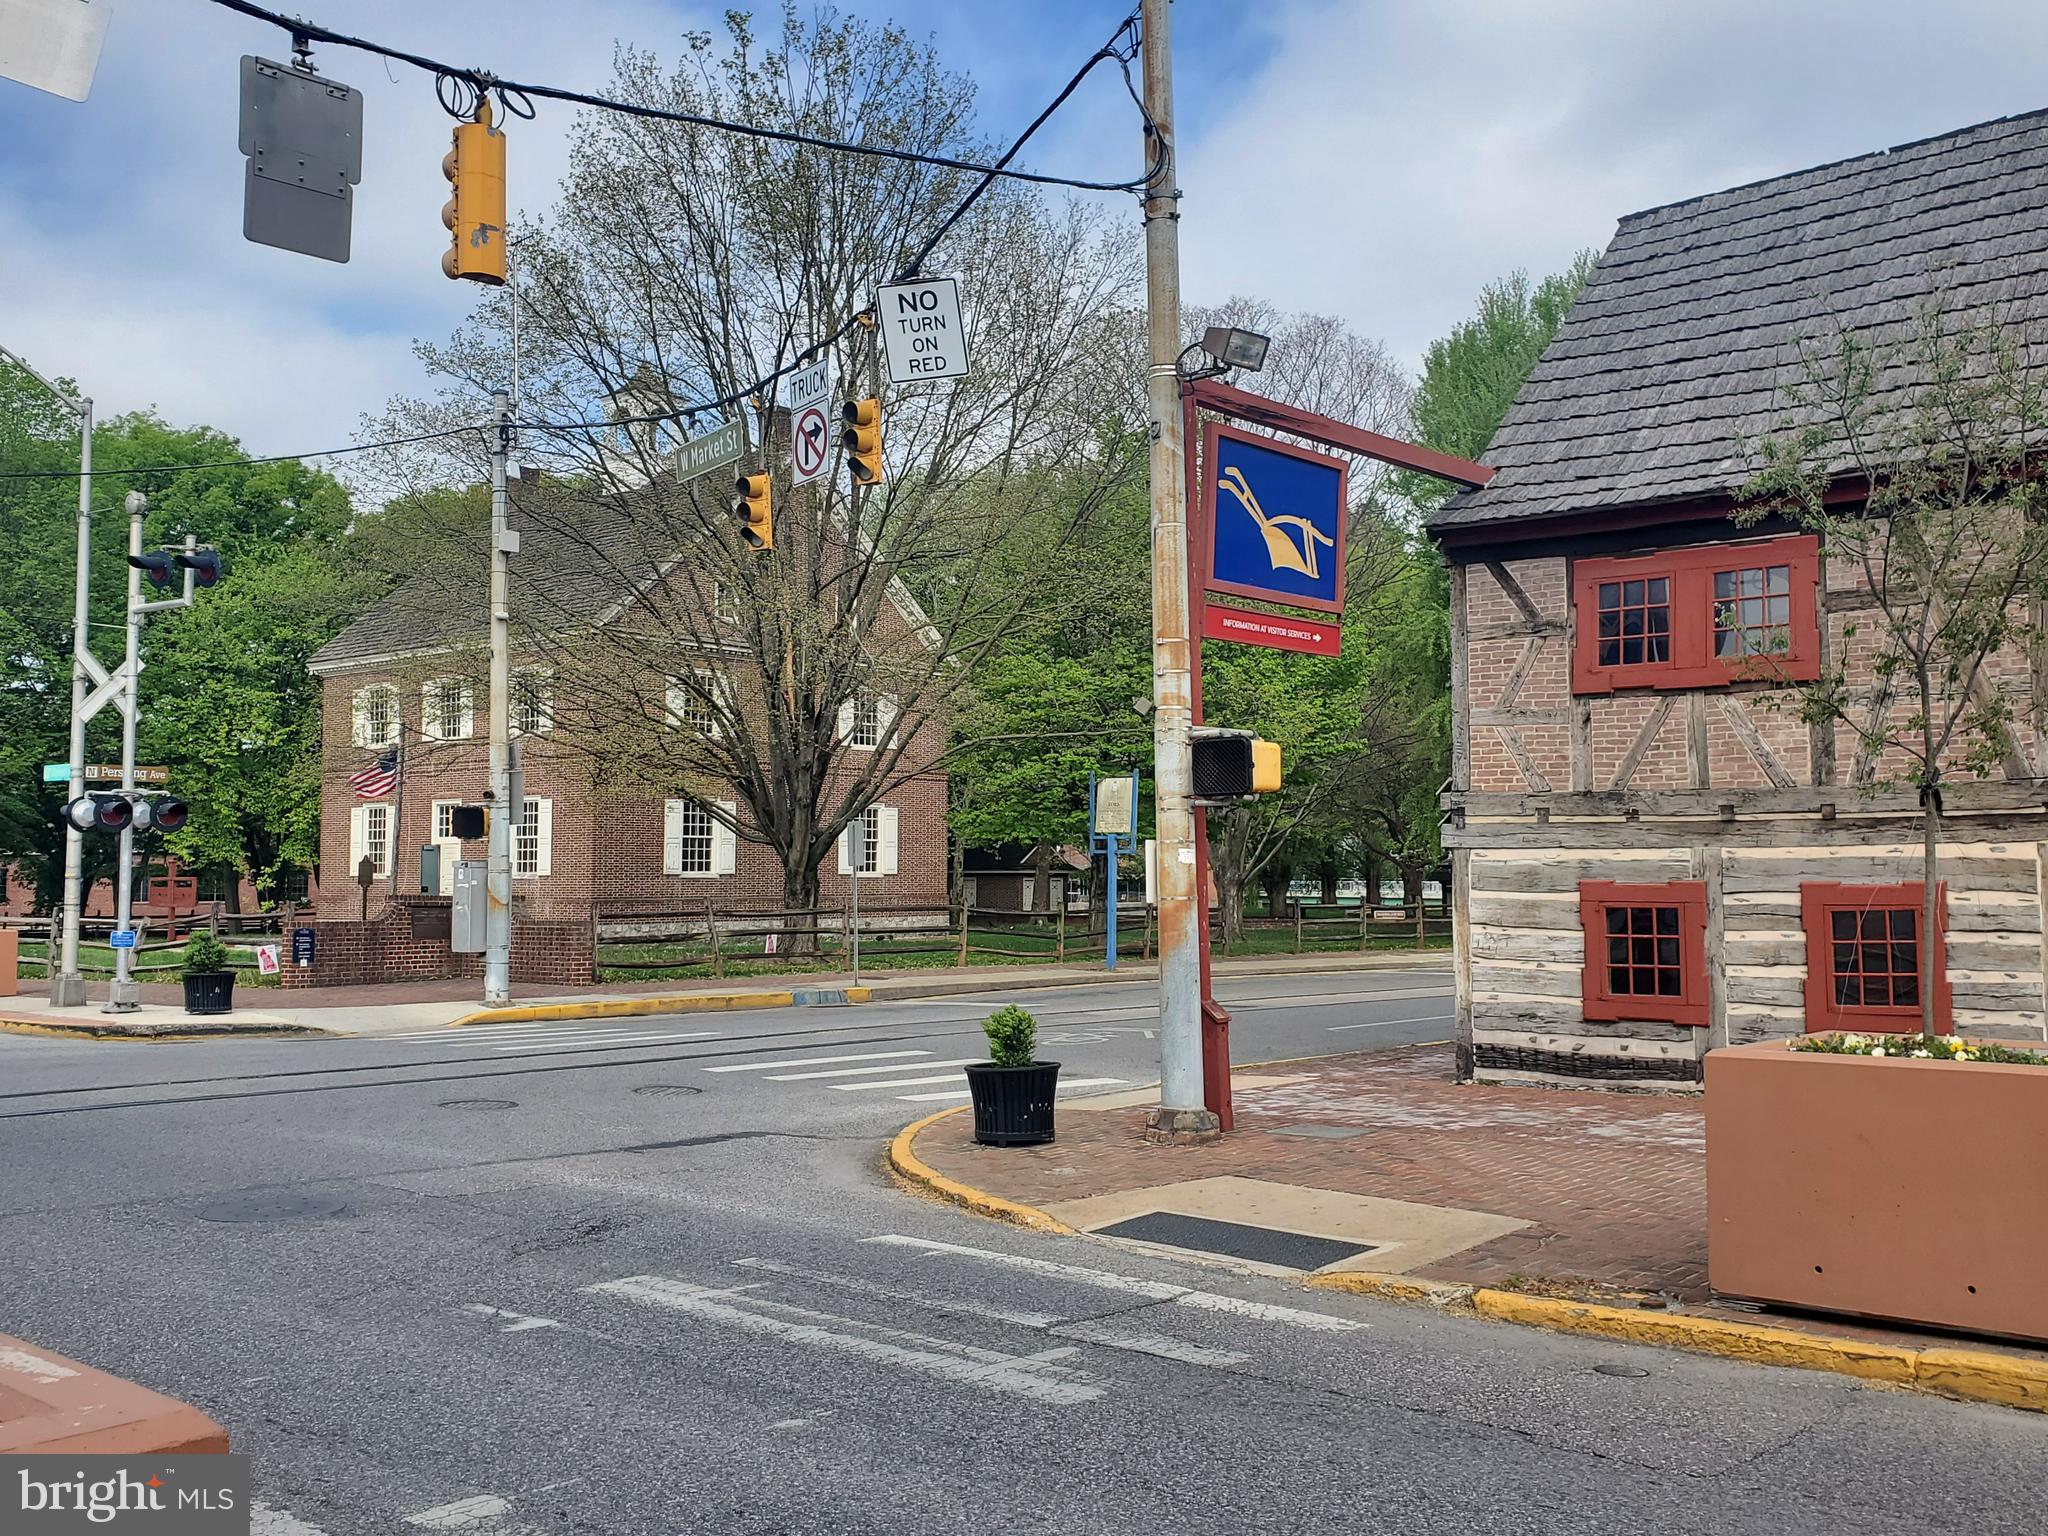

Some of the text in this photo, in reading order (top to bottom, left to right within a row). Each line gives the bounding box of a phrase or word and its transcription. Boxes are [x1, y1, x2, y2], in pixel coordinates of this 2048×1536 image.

[898, 290, 938, 314] NO
[897, 314, 946, 334] TURN
[912, 336, 938, 353] ON
[909, 355, 947, 374] RED
[791, 367, 827, 403] TRUCK
[680, 430, 737, 472] W Market St
[1223, 618, 1312, 640] INFORMATION AT VISITOR SERVICES
[87, 766, 166, 780] N Persng Ave
